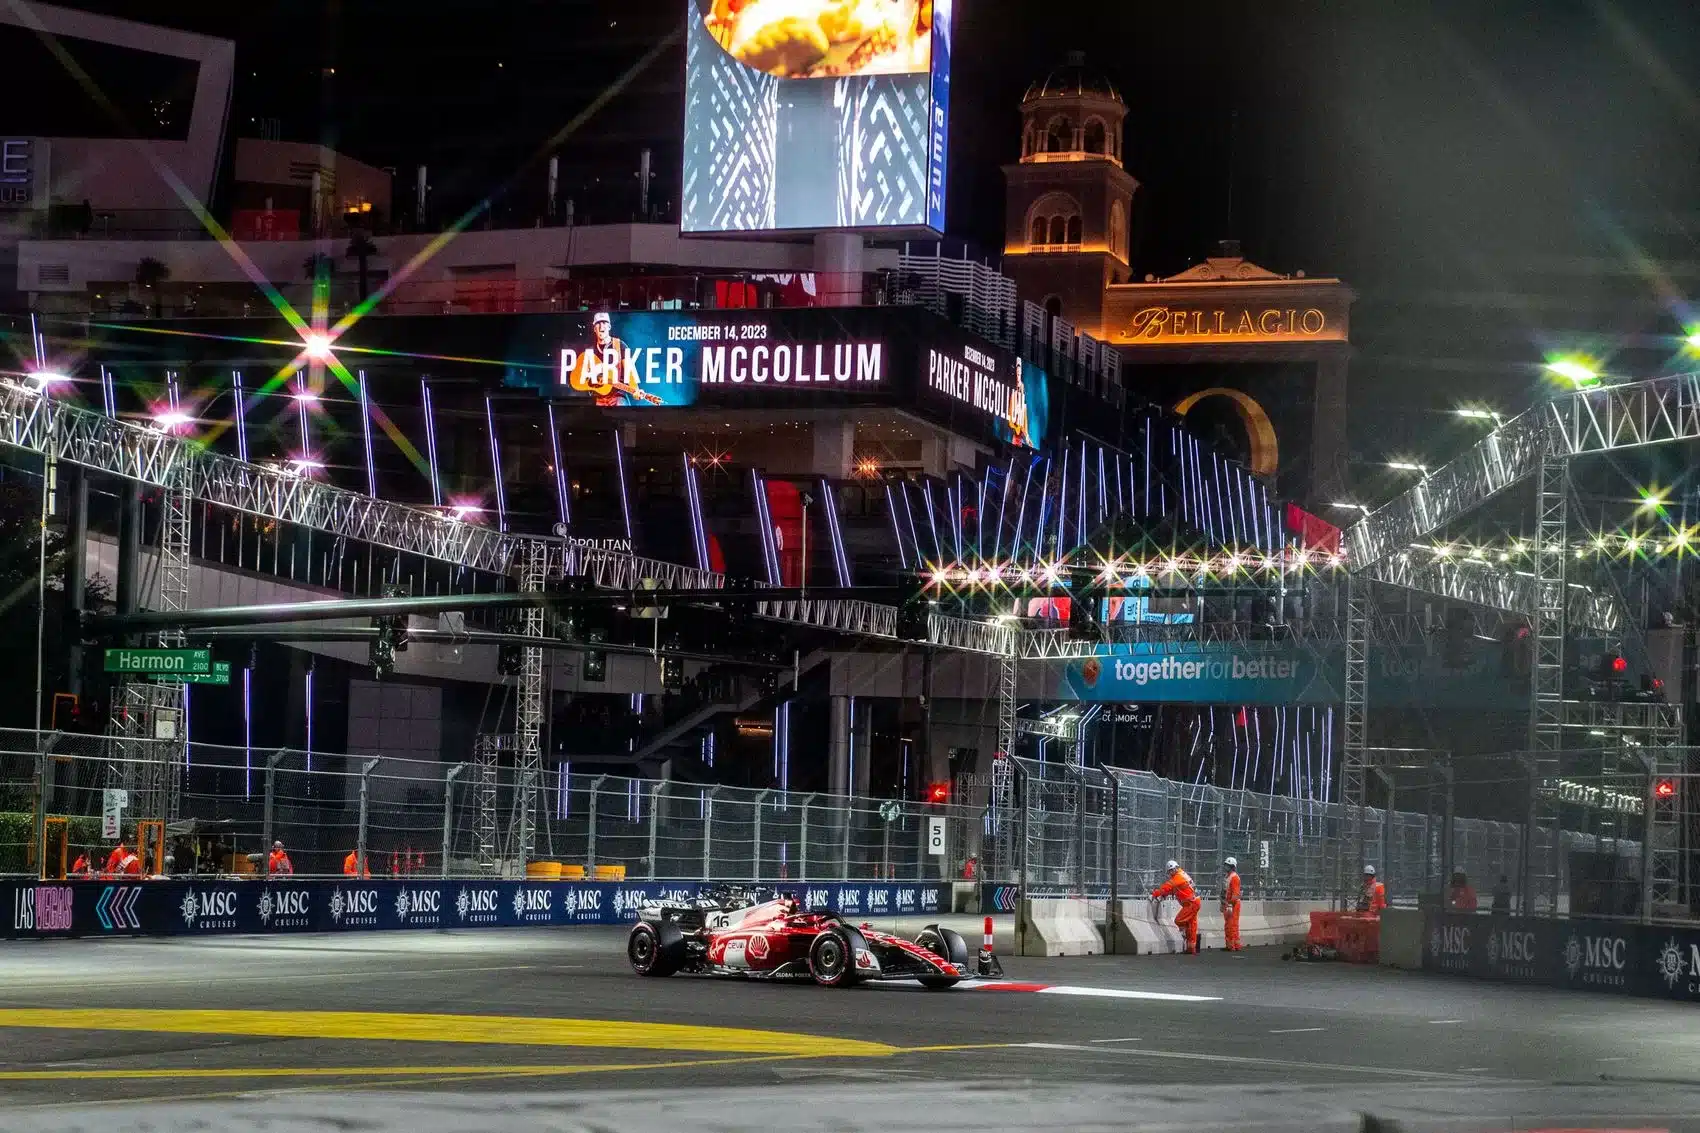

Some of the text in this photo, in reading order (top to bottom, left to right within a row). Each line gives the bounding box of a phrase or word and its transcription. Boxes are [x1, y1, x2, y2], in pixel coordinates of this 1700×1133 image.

[1121, 307, 1325, 340] BELLAGIO
[668, 325, 767, 341] DECEMBER 14, 2023
[560, 343, 882, 385] PARKER MCCOLLUM
[929, 349, 1026, 428] PARKER MCCOLLUM
[120, 651, 206, 669] Harmon AVE
[192, 662, 209, 671] 2100
[216, 663, 229, 671] BLVD
[932, 826, 942, 847] 50
[200, 892, 237, 917] MSC
[275, 891, 309, 914] MSC
[346, 890, 378, 913] MSC
[411, 890, 441, 912] MSC
[470, 889, 498, 911] MSC
[526, 890, 552, 910] MSC
[577, 890, 601, 910] MSC
[812, 889, 829, 906] MSC
[844, 889, 860, 906] MSC
[873, 889, 889, 905] MSC
[901, 889, 915, 905] MSC
[925, 889, 938, 904] MSC
[15, 887, 73, 930] LAS VEGAS
[200, 920, 236, 929] CRUISES
[275, 918, 309, 927] CRUISES
[345, 916, 377, 925] CRUISES
[410, 915, 440, 923] CRUISES
[469, 914, 497, 922] CRUISES
[712, 915, 729, 928] 16
[1442, 926, 1470, 954] MSC
[1501, 931, 1536, 961] MSC
[1584, 935, 1626, 969] MSC
[1583, 972, 1626, 986] CRUISES
